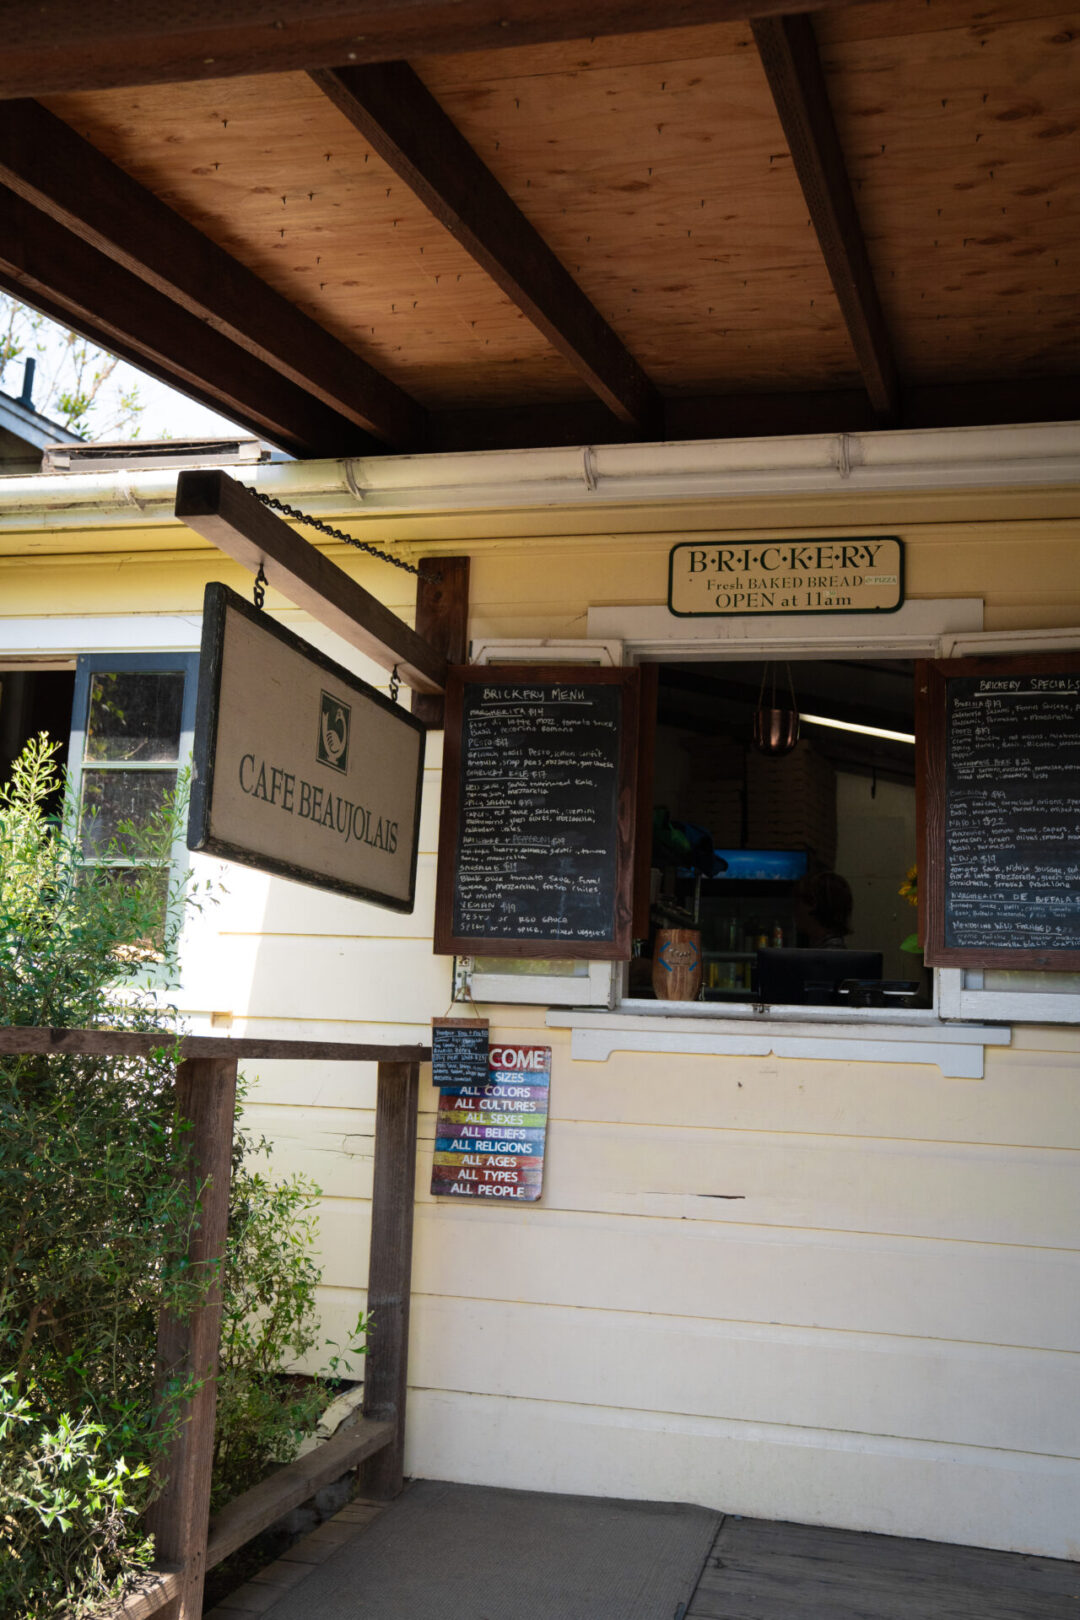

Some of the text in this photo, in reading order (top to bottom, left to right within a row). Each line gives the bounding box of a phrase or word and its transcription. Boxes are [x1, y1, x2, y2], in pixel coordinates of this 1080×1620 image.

[707, 577, 743, 591] Fresh
[748, 577, 803, 589] BAKED
[808, 576, 863, 587] BREAD
[716, 593, 774, 608] OPEN
[781, 593, 797, 607] at
[552, 688, 584, 701] MENU
[239, 754, 398, 854] CAFE BEAUJOLAIS
[489, 1049, 544, 1068] COME
[496, 1072, 524, 1082] SIZES
[460, 1086, 530, 1097] ALL COLORS
[455, 1099, 536, 1111] ALL CULTURES
[466, 1114, 523, 1124] ALL SEXES
[461, 1127, 525, 1139] ALL BELIEFS
[450, 1140, 532, 1153] ALL RELIGIONS
[462, 1155, 516, 1167] ALL AGES
[458, 1170, 518, 1182] ALL TYPES
[450, 1183, 524, 1197] ALL PEOPLE
